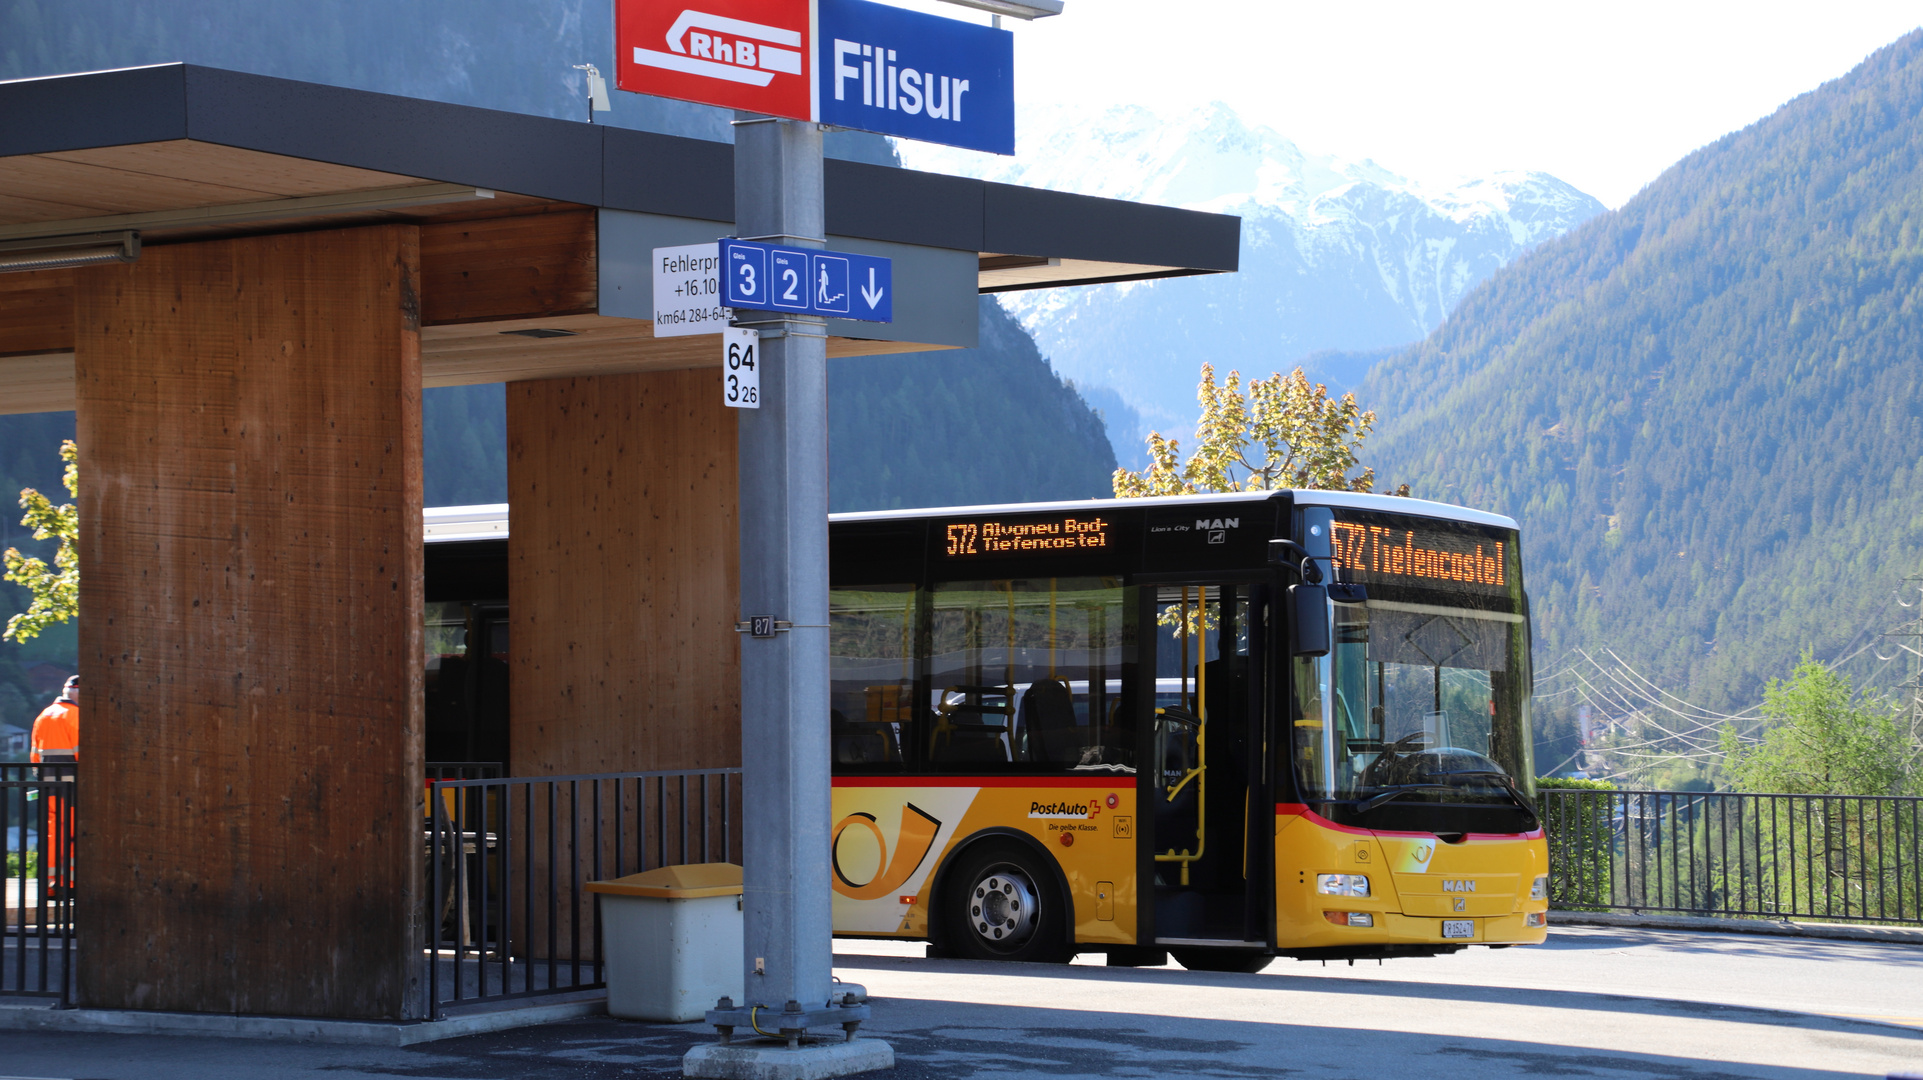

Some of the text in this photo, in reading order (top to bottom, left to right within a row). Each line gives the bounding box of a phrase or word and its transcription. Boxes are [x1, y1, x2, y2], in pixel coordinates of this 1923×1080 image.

[690, 31, 757, 68] RhB
[834, 38, 970, 122] Filisur
[733, 252, 746, 261] Gleis
[776, 257, 788, 265] Gleis
[674, 277, 720, 297] +16.10
[739, 264, 756, 296] 3
[782, 269, 798, 301] 2
[728, 342, 755, 371] 64
[728, 374, 757, 403] 3 26
[1195, 517, 1239, 530] MAN
[947, 523, 977, 555] 572
[983, 532, 1106, 551] Tiefencastel
[1330, 521, 1505, 586] 572 Tiefencastel
[755, 618, 770, 634] 87
[1030, 802, 1088, 815] PostAuto
[1060, 824, 1077, 832] gelbe
[1443, 880, 1476, 892] MAN
